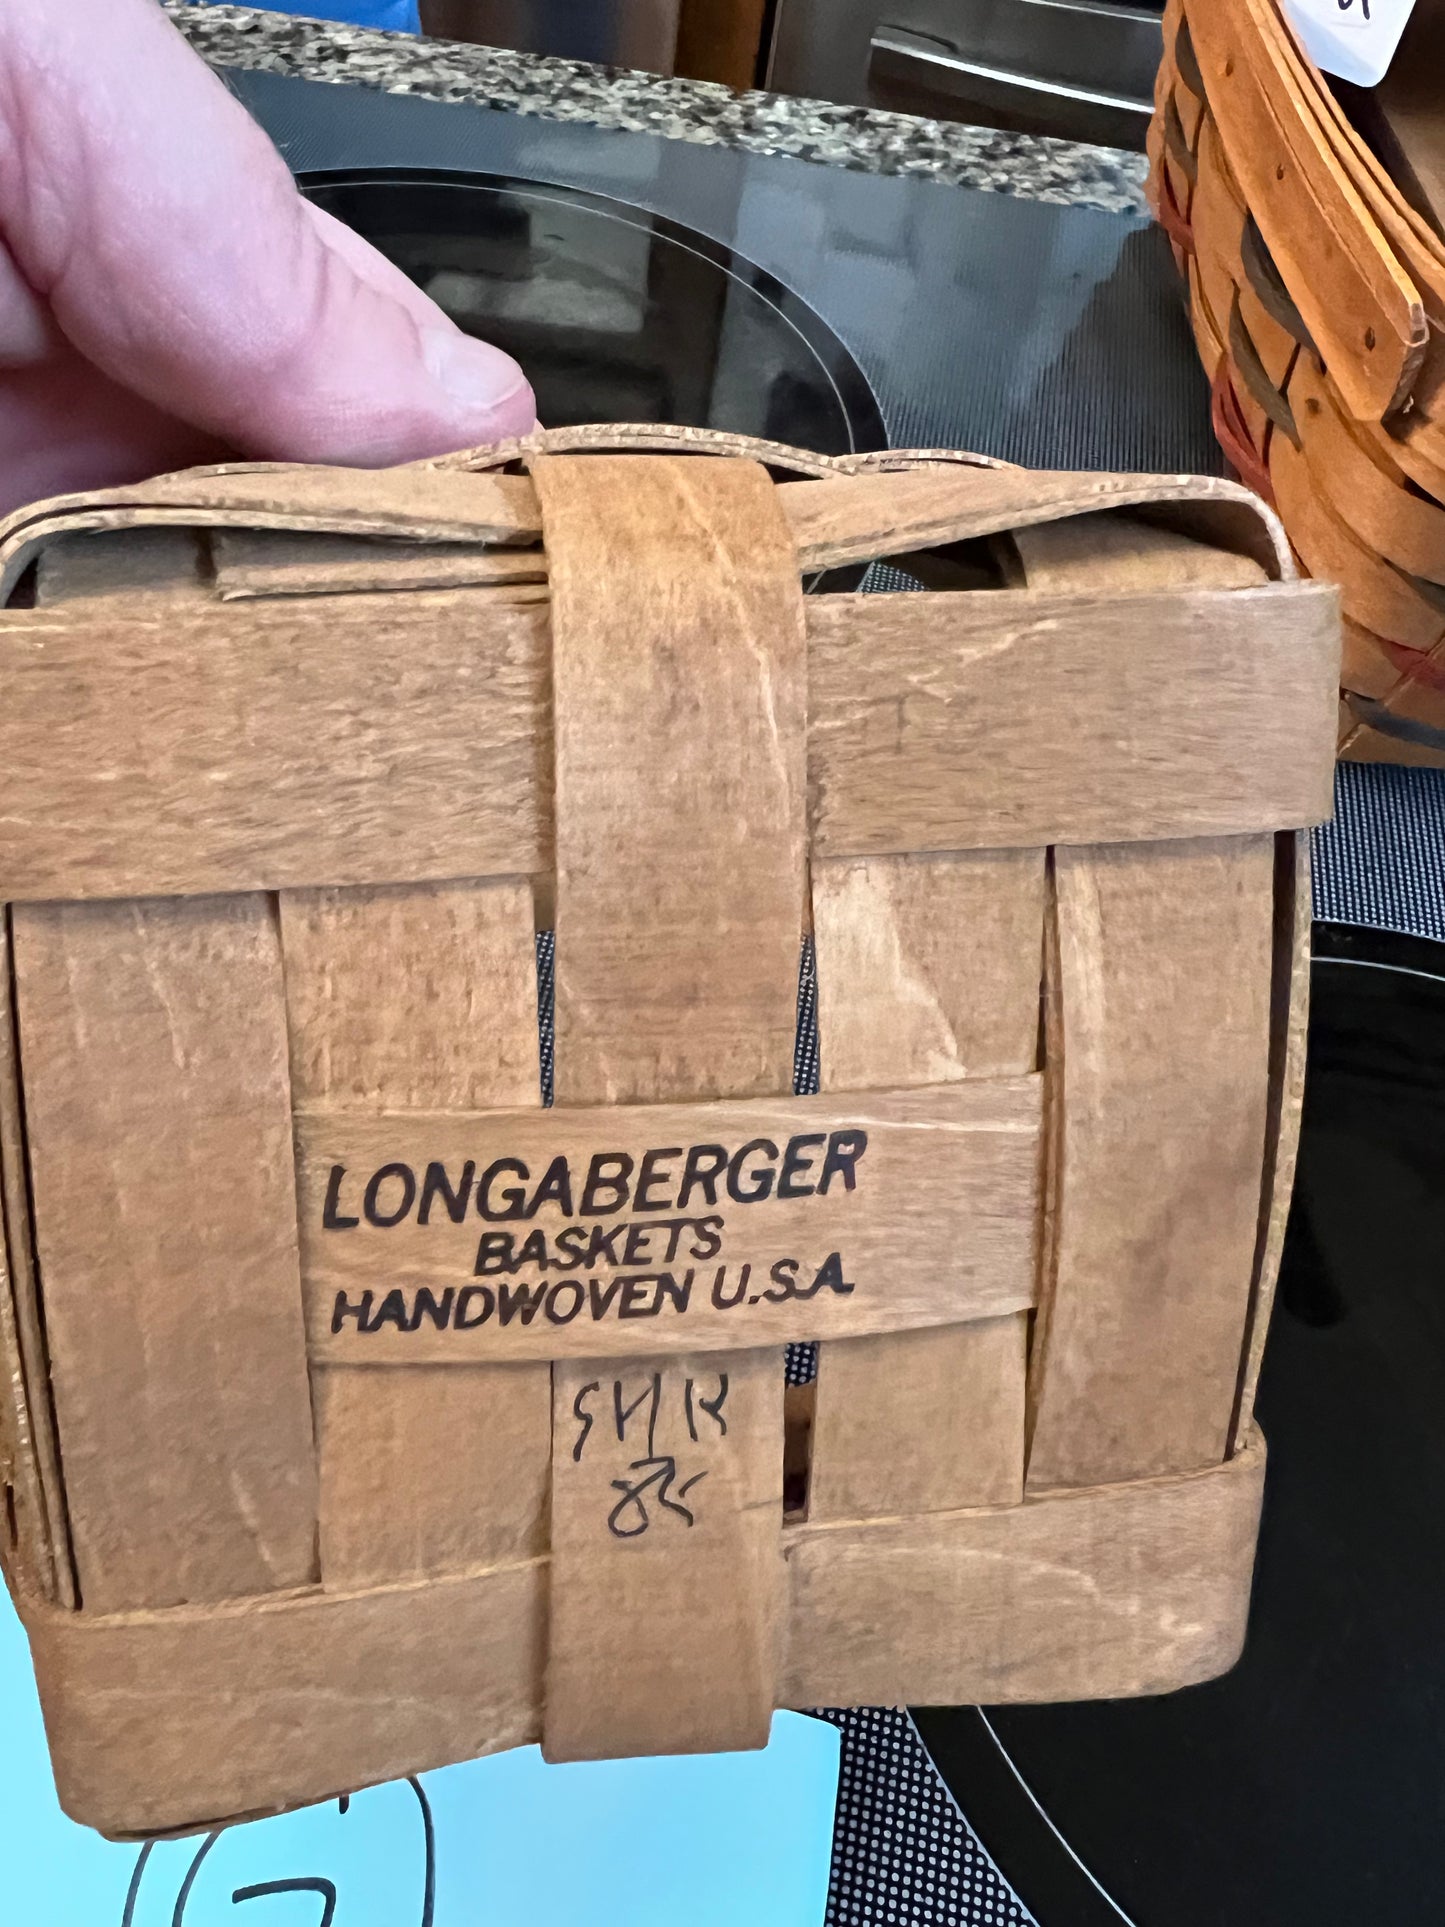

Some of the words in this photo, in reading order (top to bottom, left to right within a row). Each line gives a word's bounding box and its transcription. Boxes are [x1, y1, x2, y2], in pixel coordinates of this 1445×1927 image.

[322, 1128, 868, 1230] LONGABERGER
[473, 1214, 725, 1277] BASKETS
[330, 1268, 695, 1334] HANDWOVEN
